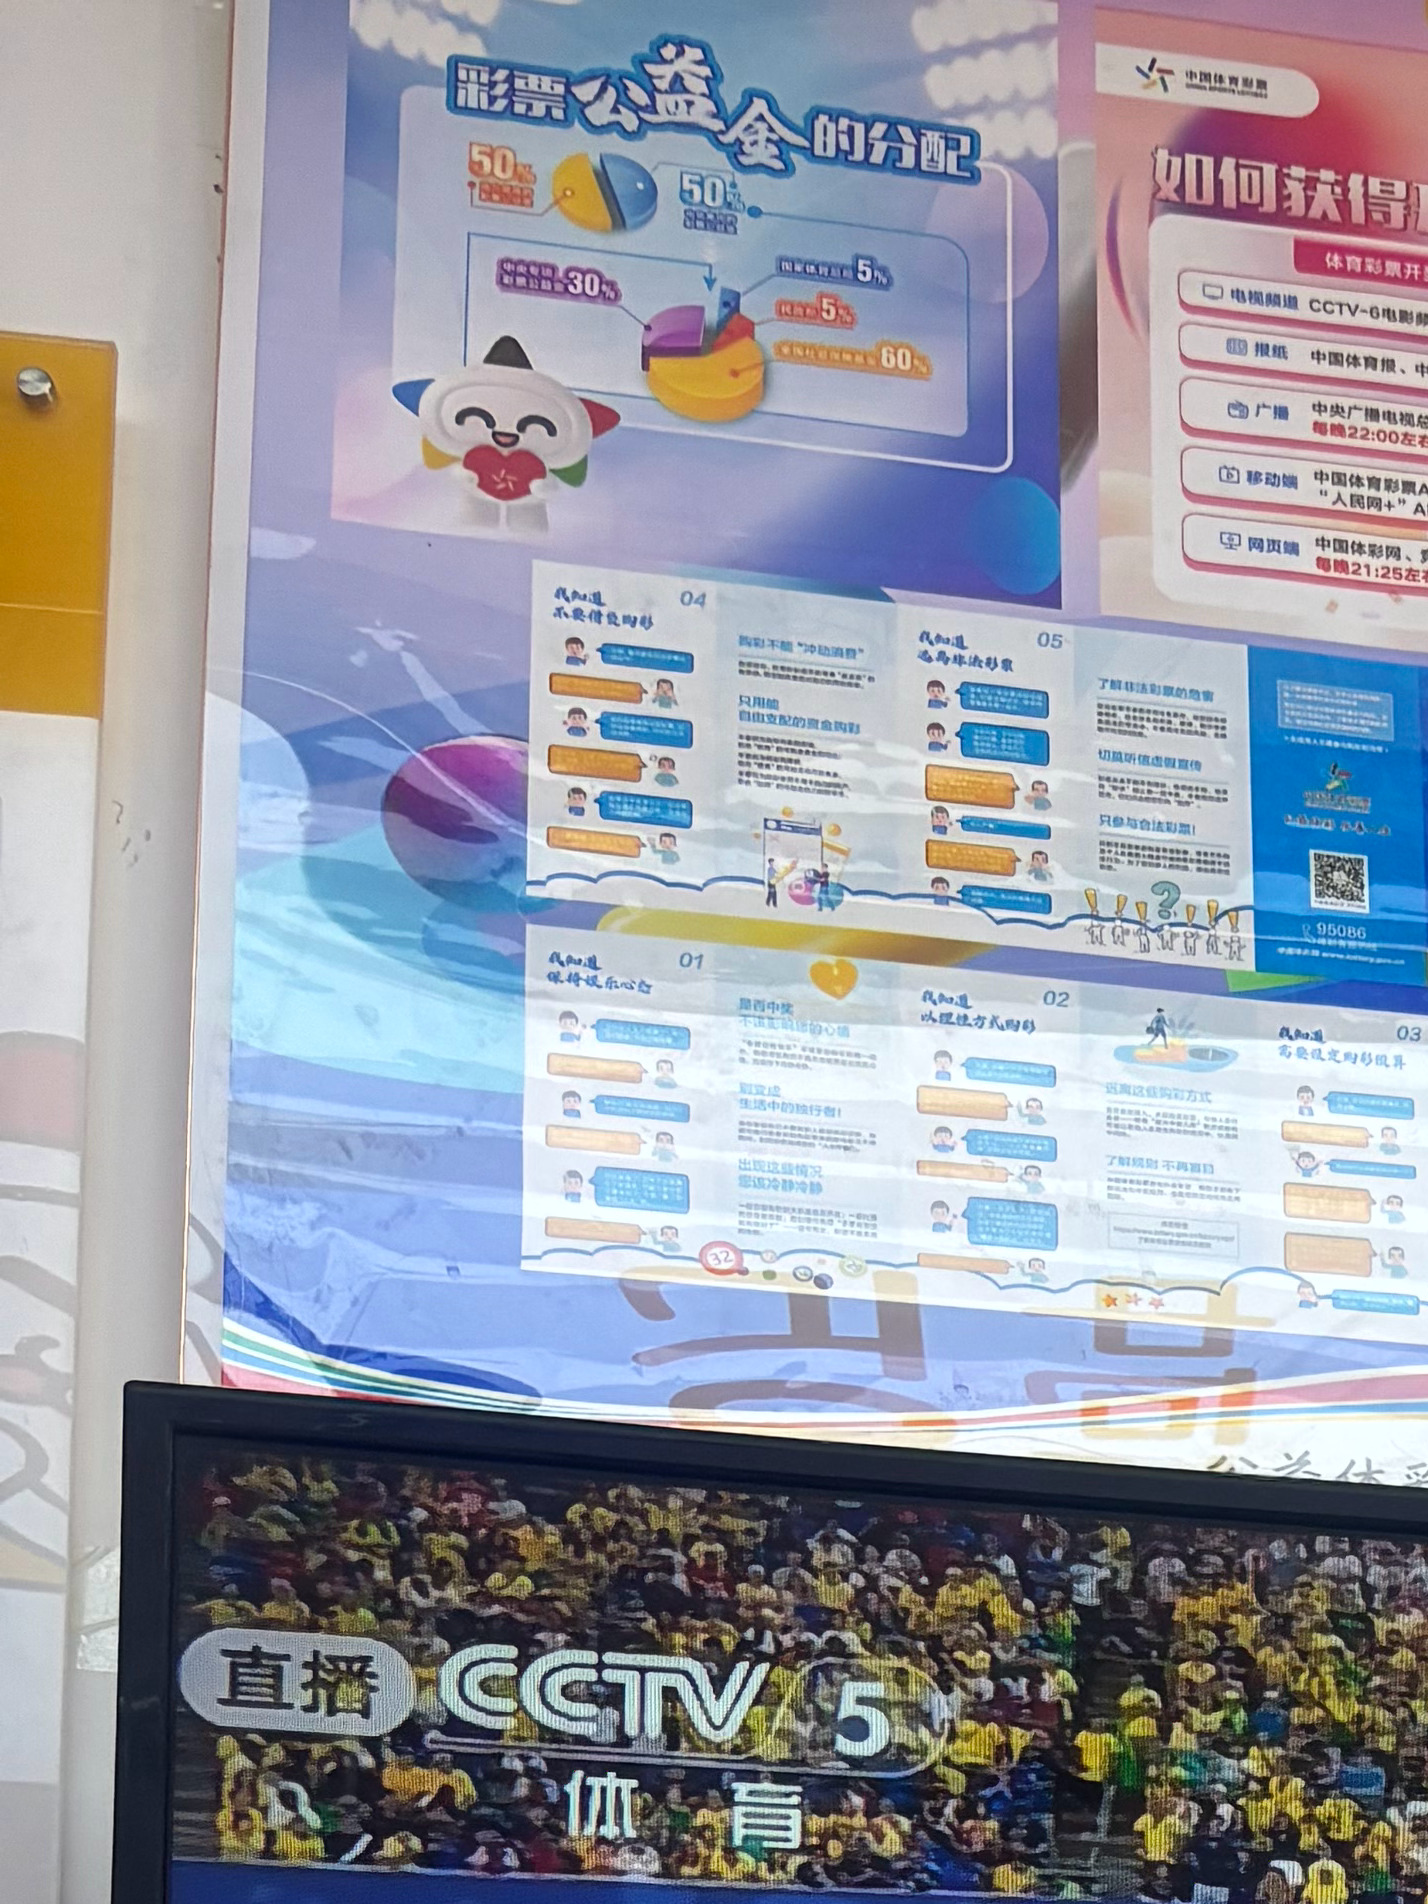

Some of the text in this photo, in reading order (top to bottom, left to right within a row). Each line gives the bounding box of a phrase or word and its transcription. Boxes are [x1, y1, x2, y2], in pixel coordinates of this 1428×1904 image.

[1185, 70, 1267, 90] 中国体育彩票
[455, 42, 976, 176] 彩票公益金的分配
[470, 143, 536, 184] 50%
[1230, 285, 1300, 313] 电视频道
[1253, 341, 1289, 363] 报纸
[1253, 402, 1291, 423] 广播
[1245, 468, 1299, 493] 移动端
[1246, 534, 1301, 560] 网页端
[680, 590, 707, 609] 04
[1037, 632, 1064, 650] 05
[679, 951, 705, 969] 01
[1043, 990, 1070, 1008] 02
[1396, 1025, 1422, 1042] 03
[219, 1645, 892, 1756] 直播 CCTV 5
[567, 1770, 802, 1849] 体育
